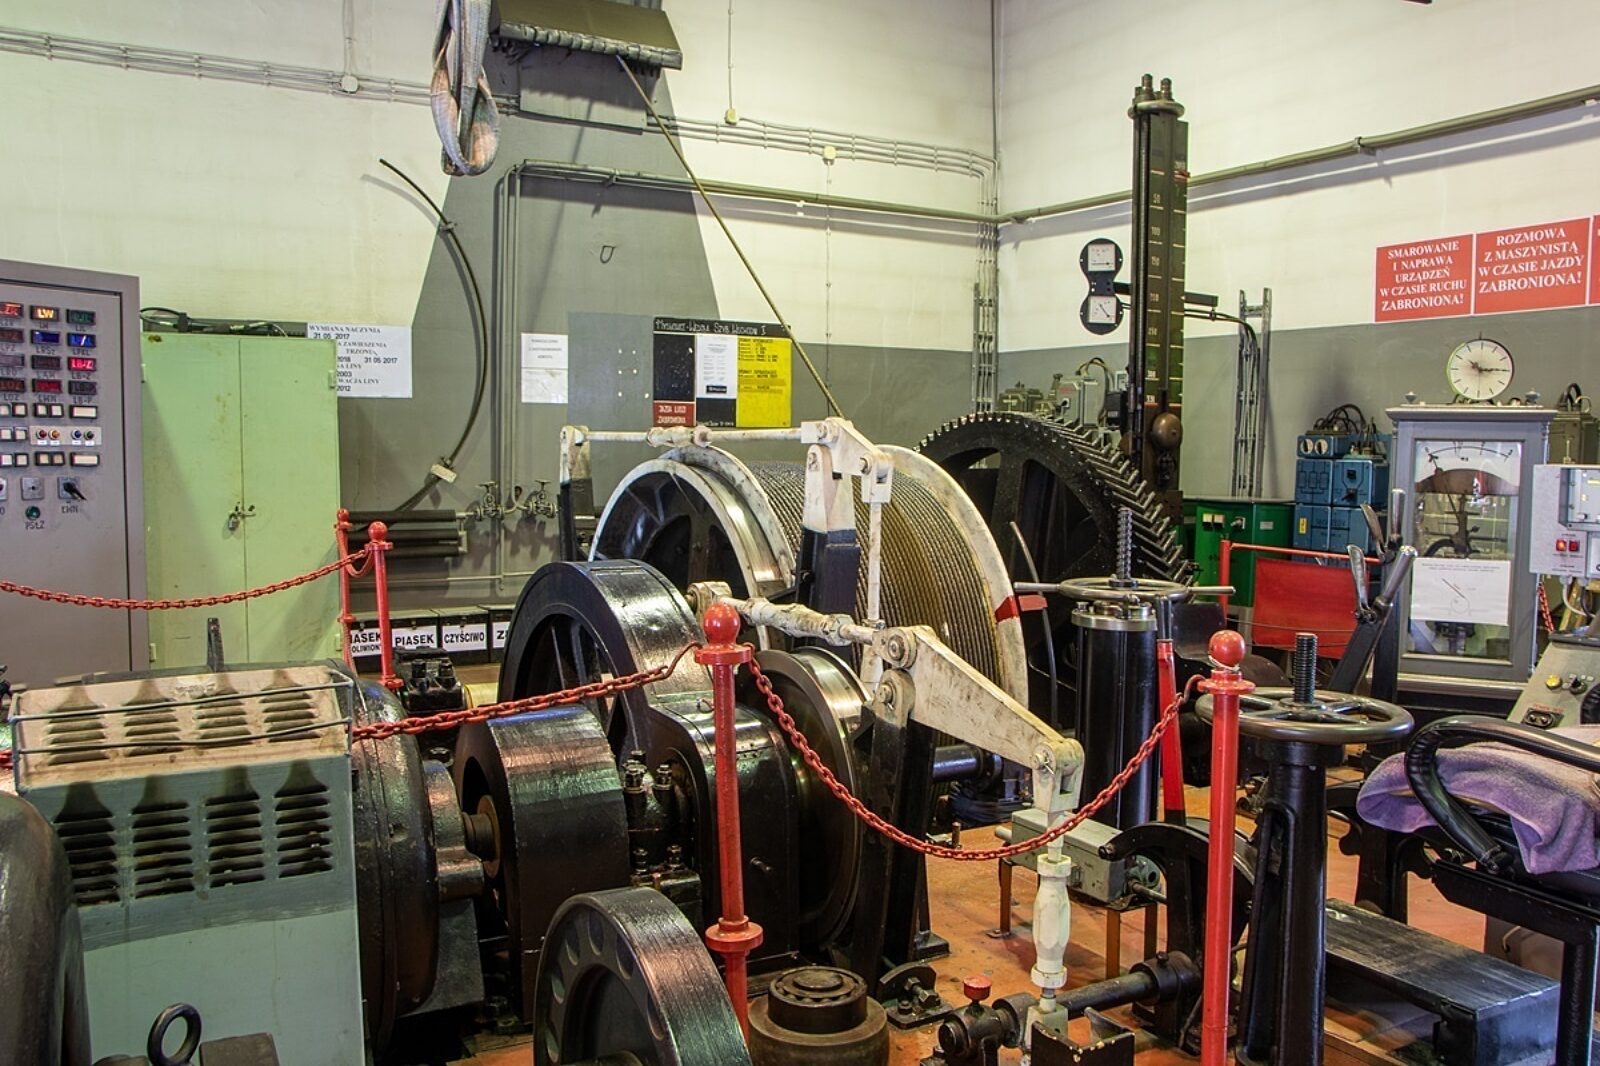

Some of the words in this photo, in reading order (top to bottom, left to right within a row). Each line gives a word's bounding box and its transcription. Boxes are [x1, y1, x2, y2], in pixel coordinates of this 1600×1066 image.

[1496, 227, 1566, 246] ROZMOWA
[1387, 241, 1460, 259] SMAROWANIE
[1484, 251, 1493, 262] Z
[1495, 241, 1578, 261] MASZYNISTĄ
[1393, 262, 1397, 271] I
[1401, 255, 1453, 270] NAPRAWA
[1478, 266, 1491, 277] W
[1492, 261, 1538, 276] CZASIE
[1540, 255, 1584, 270] JAZDY
[1395, 266, 1450, 283] URZĄDZEŃ
[1479, 271, 1582, 294] ZABRONIONA!
[1379, 288, 1389, 297] W
[1391, 284, 1427, 296] CZASIE
[1429, 279, 1467, 292] RUCHU
[1381, 293, 1464, 311] ZABRONIONA!
[350, 631, 381, 644] IASEK
[395, 634, 434, 647] PIASEK
[443, 630, 485, 644] CZYŚCIWO
